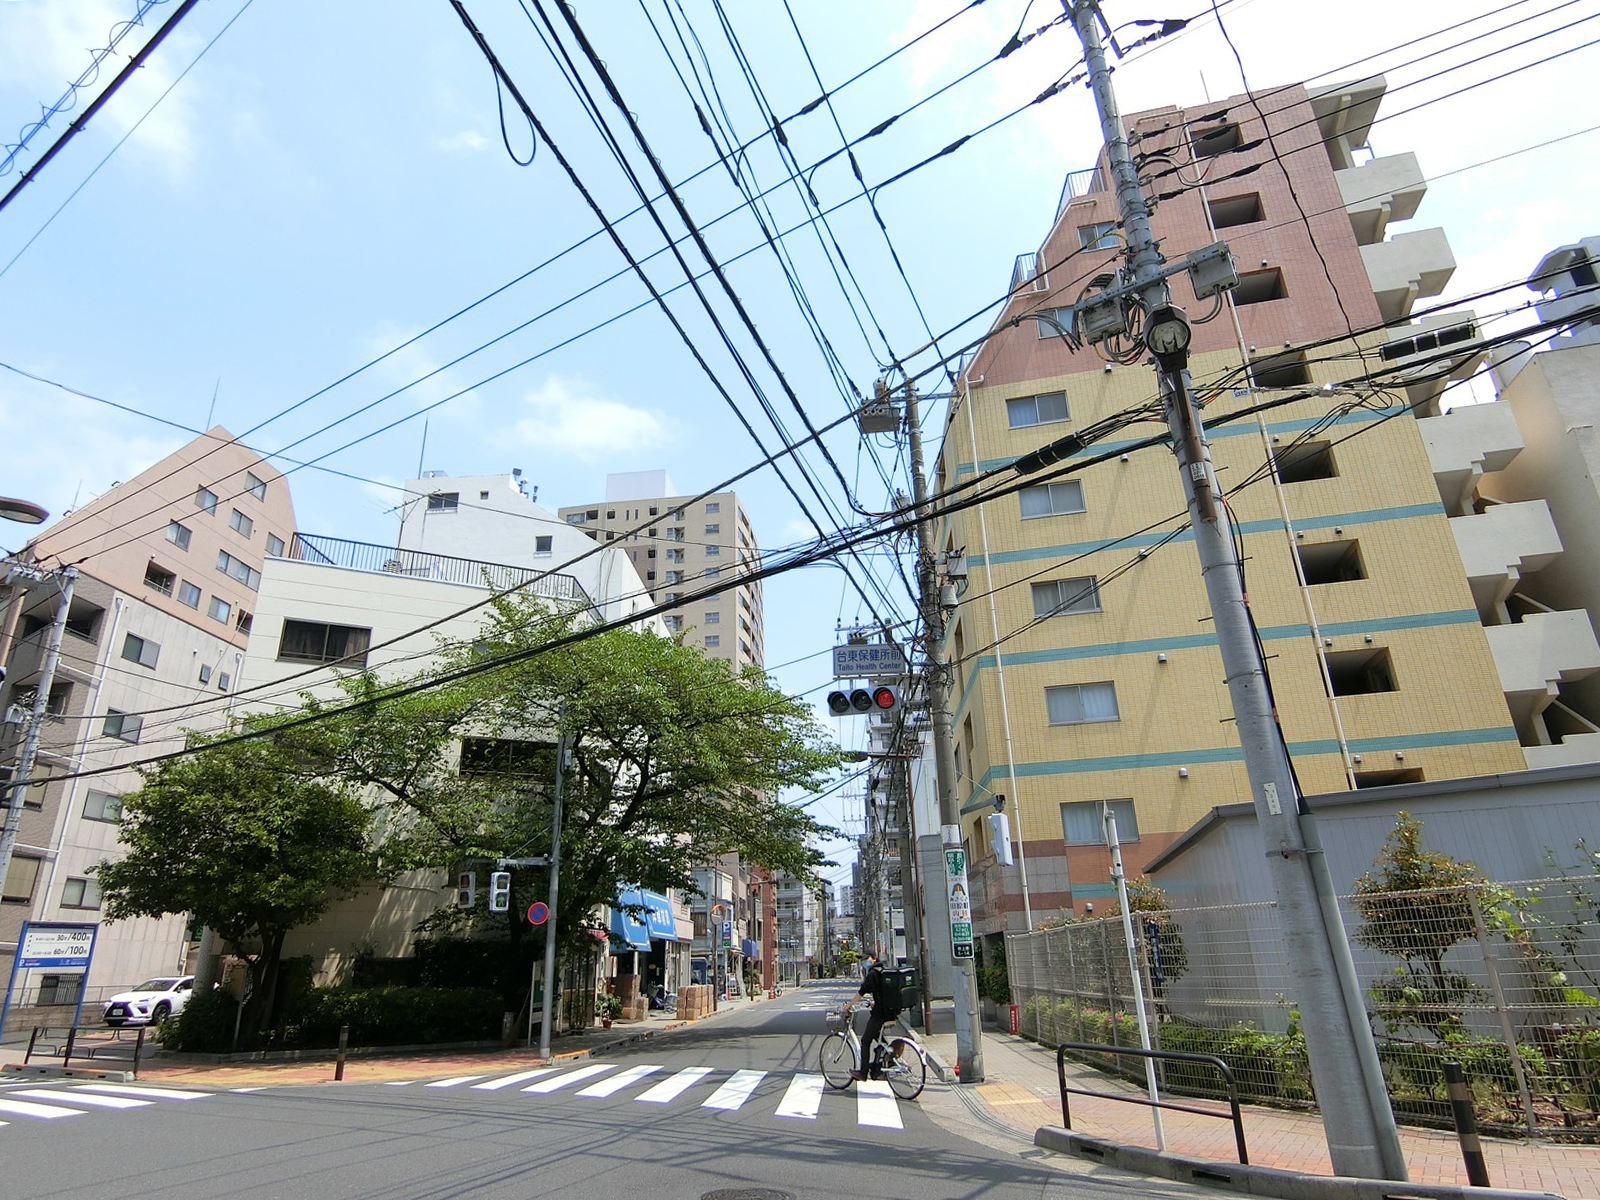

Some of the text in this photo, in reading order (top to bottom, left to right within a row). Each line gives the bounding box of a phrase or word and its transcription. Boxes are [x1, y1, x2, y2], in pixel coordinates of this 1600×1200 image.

[837, 649, 901, 663] 台東保健所前
